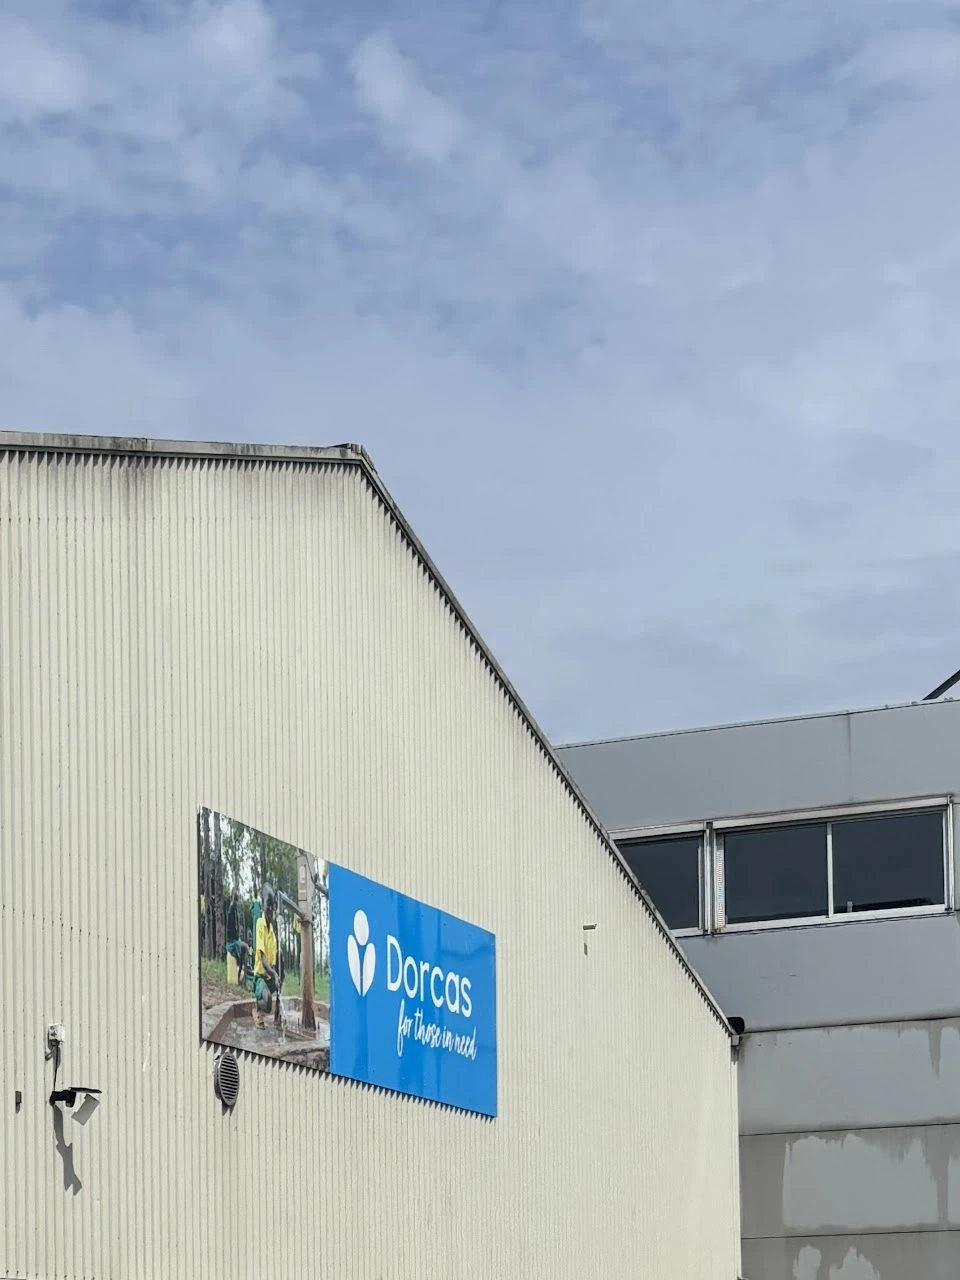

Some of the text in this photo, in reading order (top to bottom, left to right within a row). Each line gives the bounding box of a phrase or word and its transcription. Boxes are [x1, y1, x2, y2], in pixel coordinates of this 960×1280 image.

[387, 934, 472, 1018] Dorcas
[397, 998, 477, 1061] for those in need
